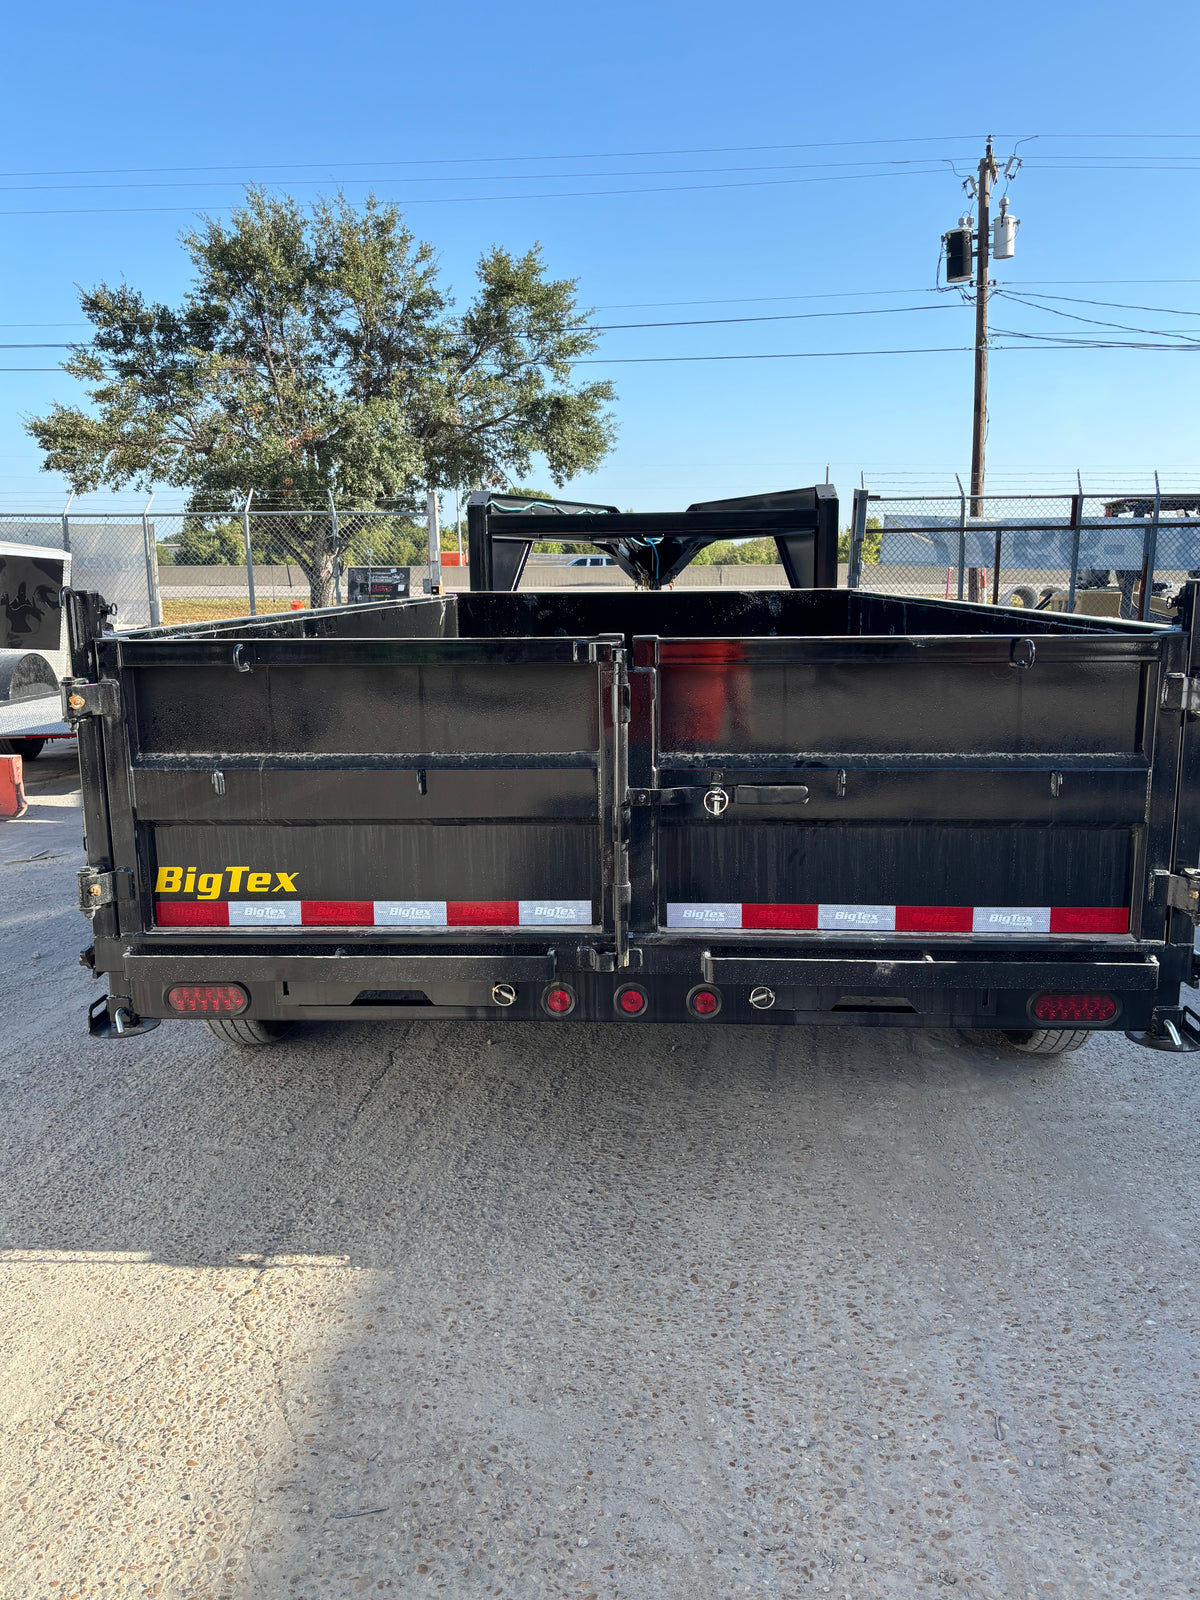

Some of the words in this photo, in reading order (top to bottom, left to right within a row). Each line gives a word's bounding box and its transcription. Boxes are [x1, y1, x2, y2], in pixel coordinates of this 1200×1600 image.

[155, 866, 299, 900] BigTex
[244, 907, 286, 918] BigTex
[316, 907, 358, 918] BigTex
[389, 907, 431, 918] BigTex
[534, 907, 576, 918] BigTex
[683, 909, 726, 920] BigTex
[835, 911, 878, 922] BigTex
[989, 914, 1033, 925] BigTex
